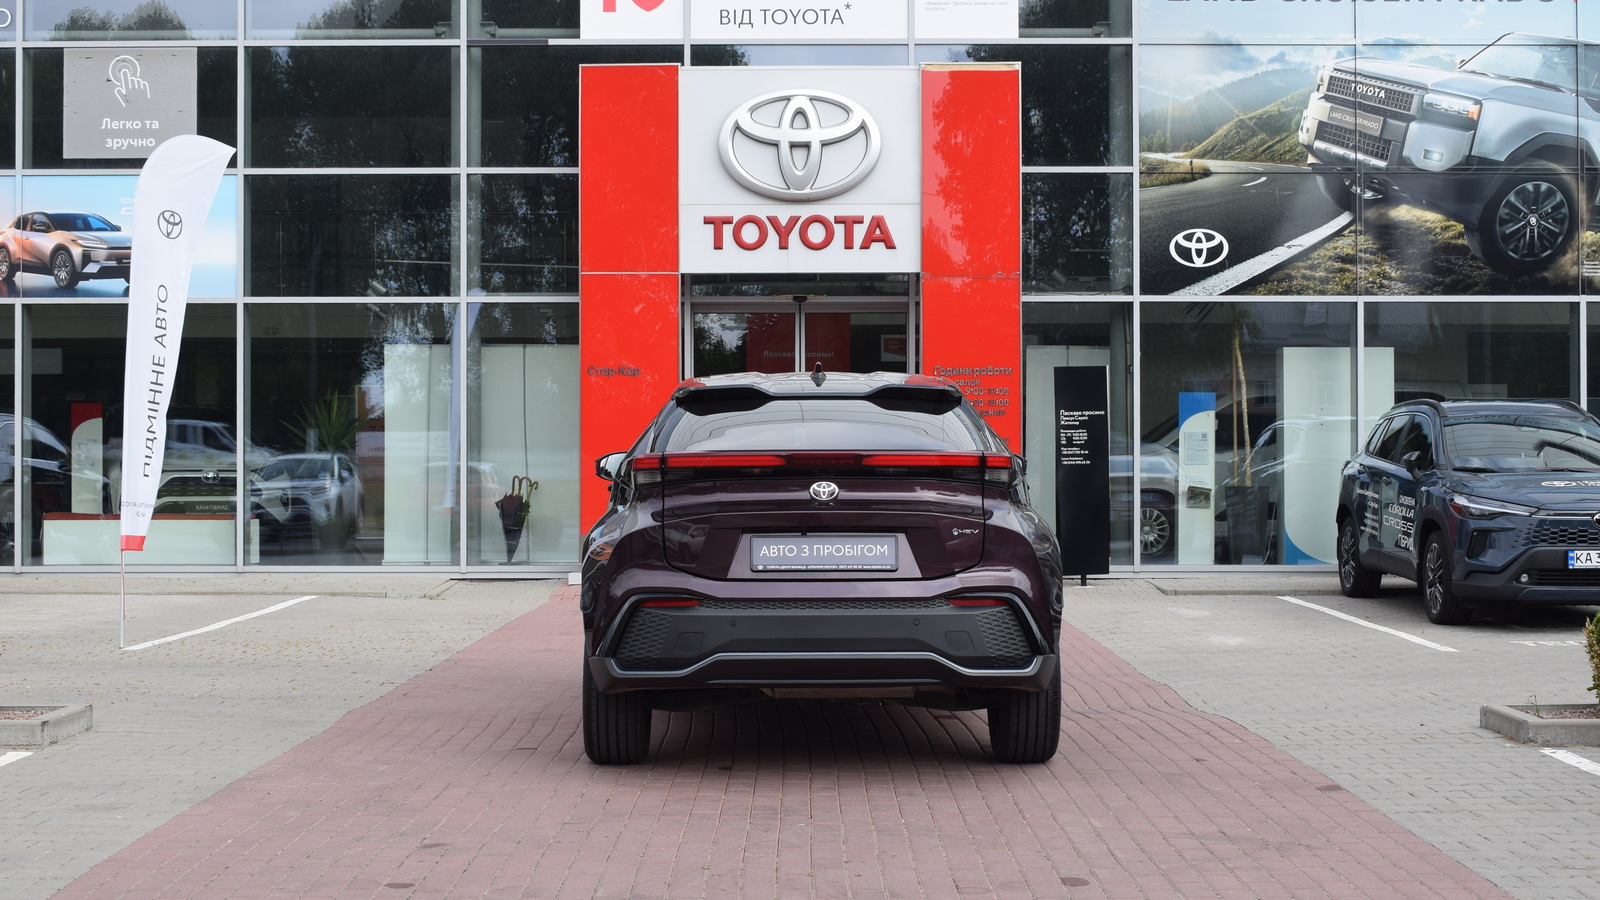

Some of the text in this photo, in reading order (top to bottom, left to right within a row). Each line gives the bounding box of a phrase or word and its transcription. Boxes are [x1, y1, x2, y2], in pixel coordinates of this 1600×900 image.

[719, 9, 754, 28] ВІД
[1351, 84, 1385, 98] TOYOTA
[100, 118, 160, 130] Легко та
[1330, 111, 1379, 129] LAND CRUISER PRADO
[105, 138, 156, 150] зручно
[704, 214, 897, 250] TOYOTA
[588, 366, 641, 377] Стар-Кар
[934, 366, 1012, 377] Години роботи
[143, 284, 168, 478] ПІДМІННЕ АВТО
[978, 408, 1006, 416] ідний
[1388, 504, 1414, 518] COROLLA
[1383, 515, 1414, 533] CROSS
[760, 546, 796, 556] АВТО
[814, 544, 888, 556] ПРОБІГОМ
[1575, 552, 1592, 564] KA
